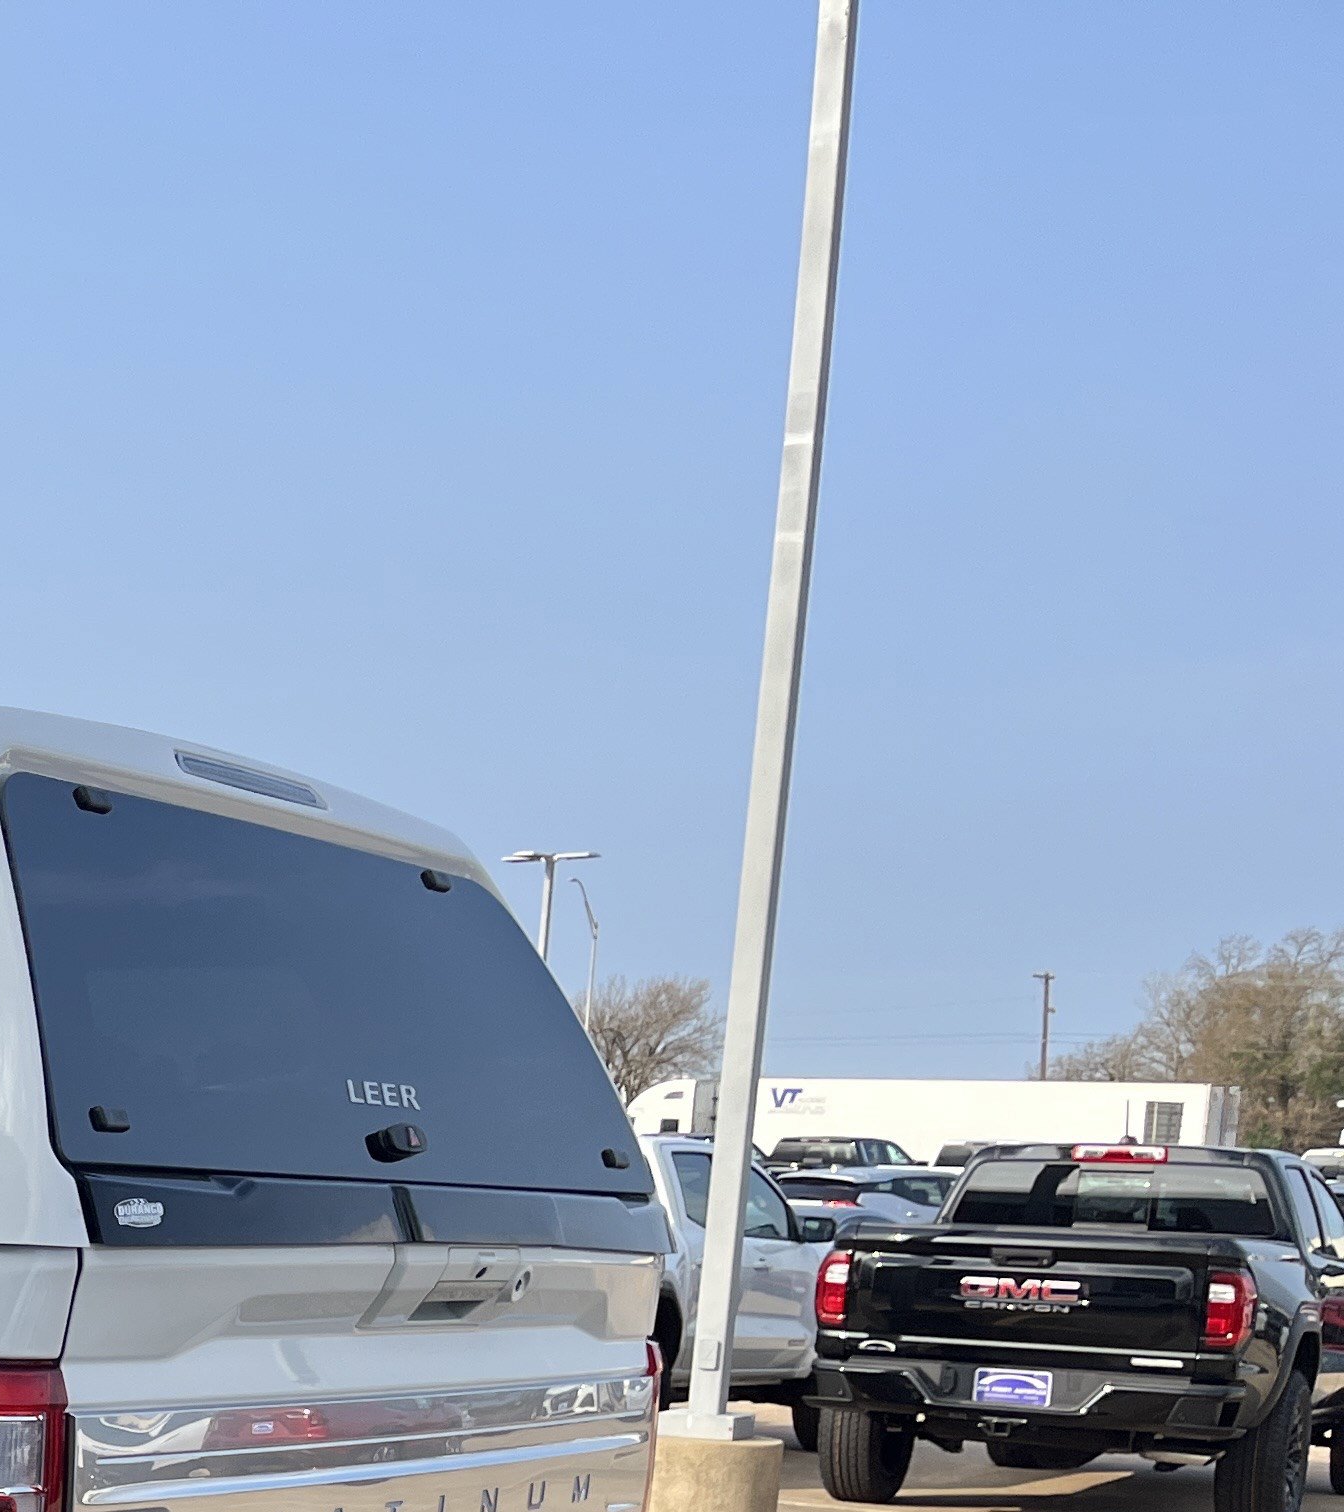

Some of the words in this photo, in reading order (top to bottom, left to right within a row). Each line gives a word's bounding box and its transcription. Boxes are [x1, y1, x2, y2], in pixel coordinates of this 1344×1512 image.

[346, 1078, 421, 1111] LEER
[771, 1087, 803, 1108] VT
[117, 1202, 164, 1216] DURANGO
[959, 1275, 1082, 1302] GMC
[964, 1300, 1071, 1314] CANYON
